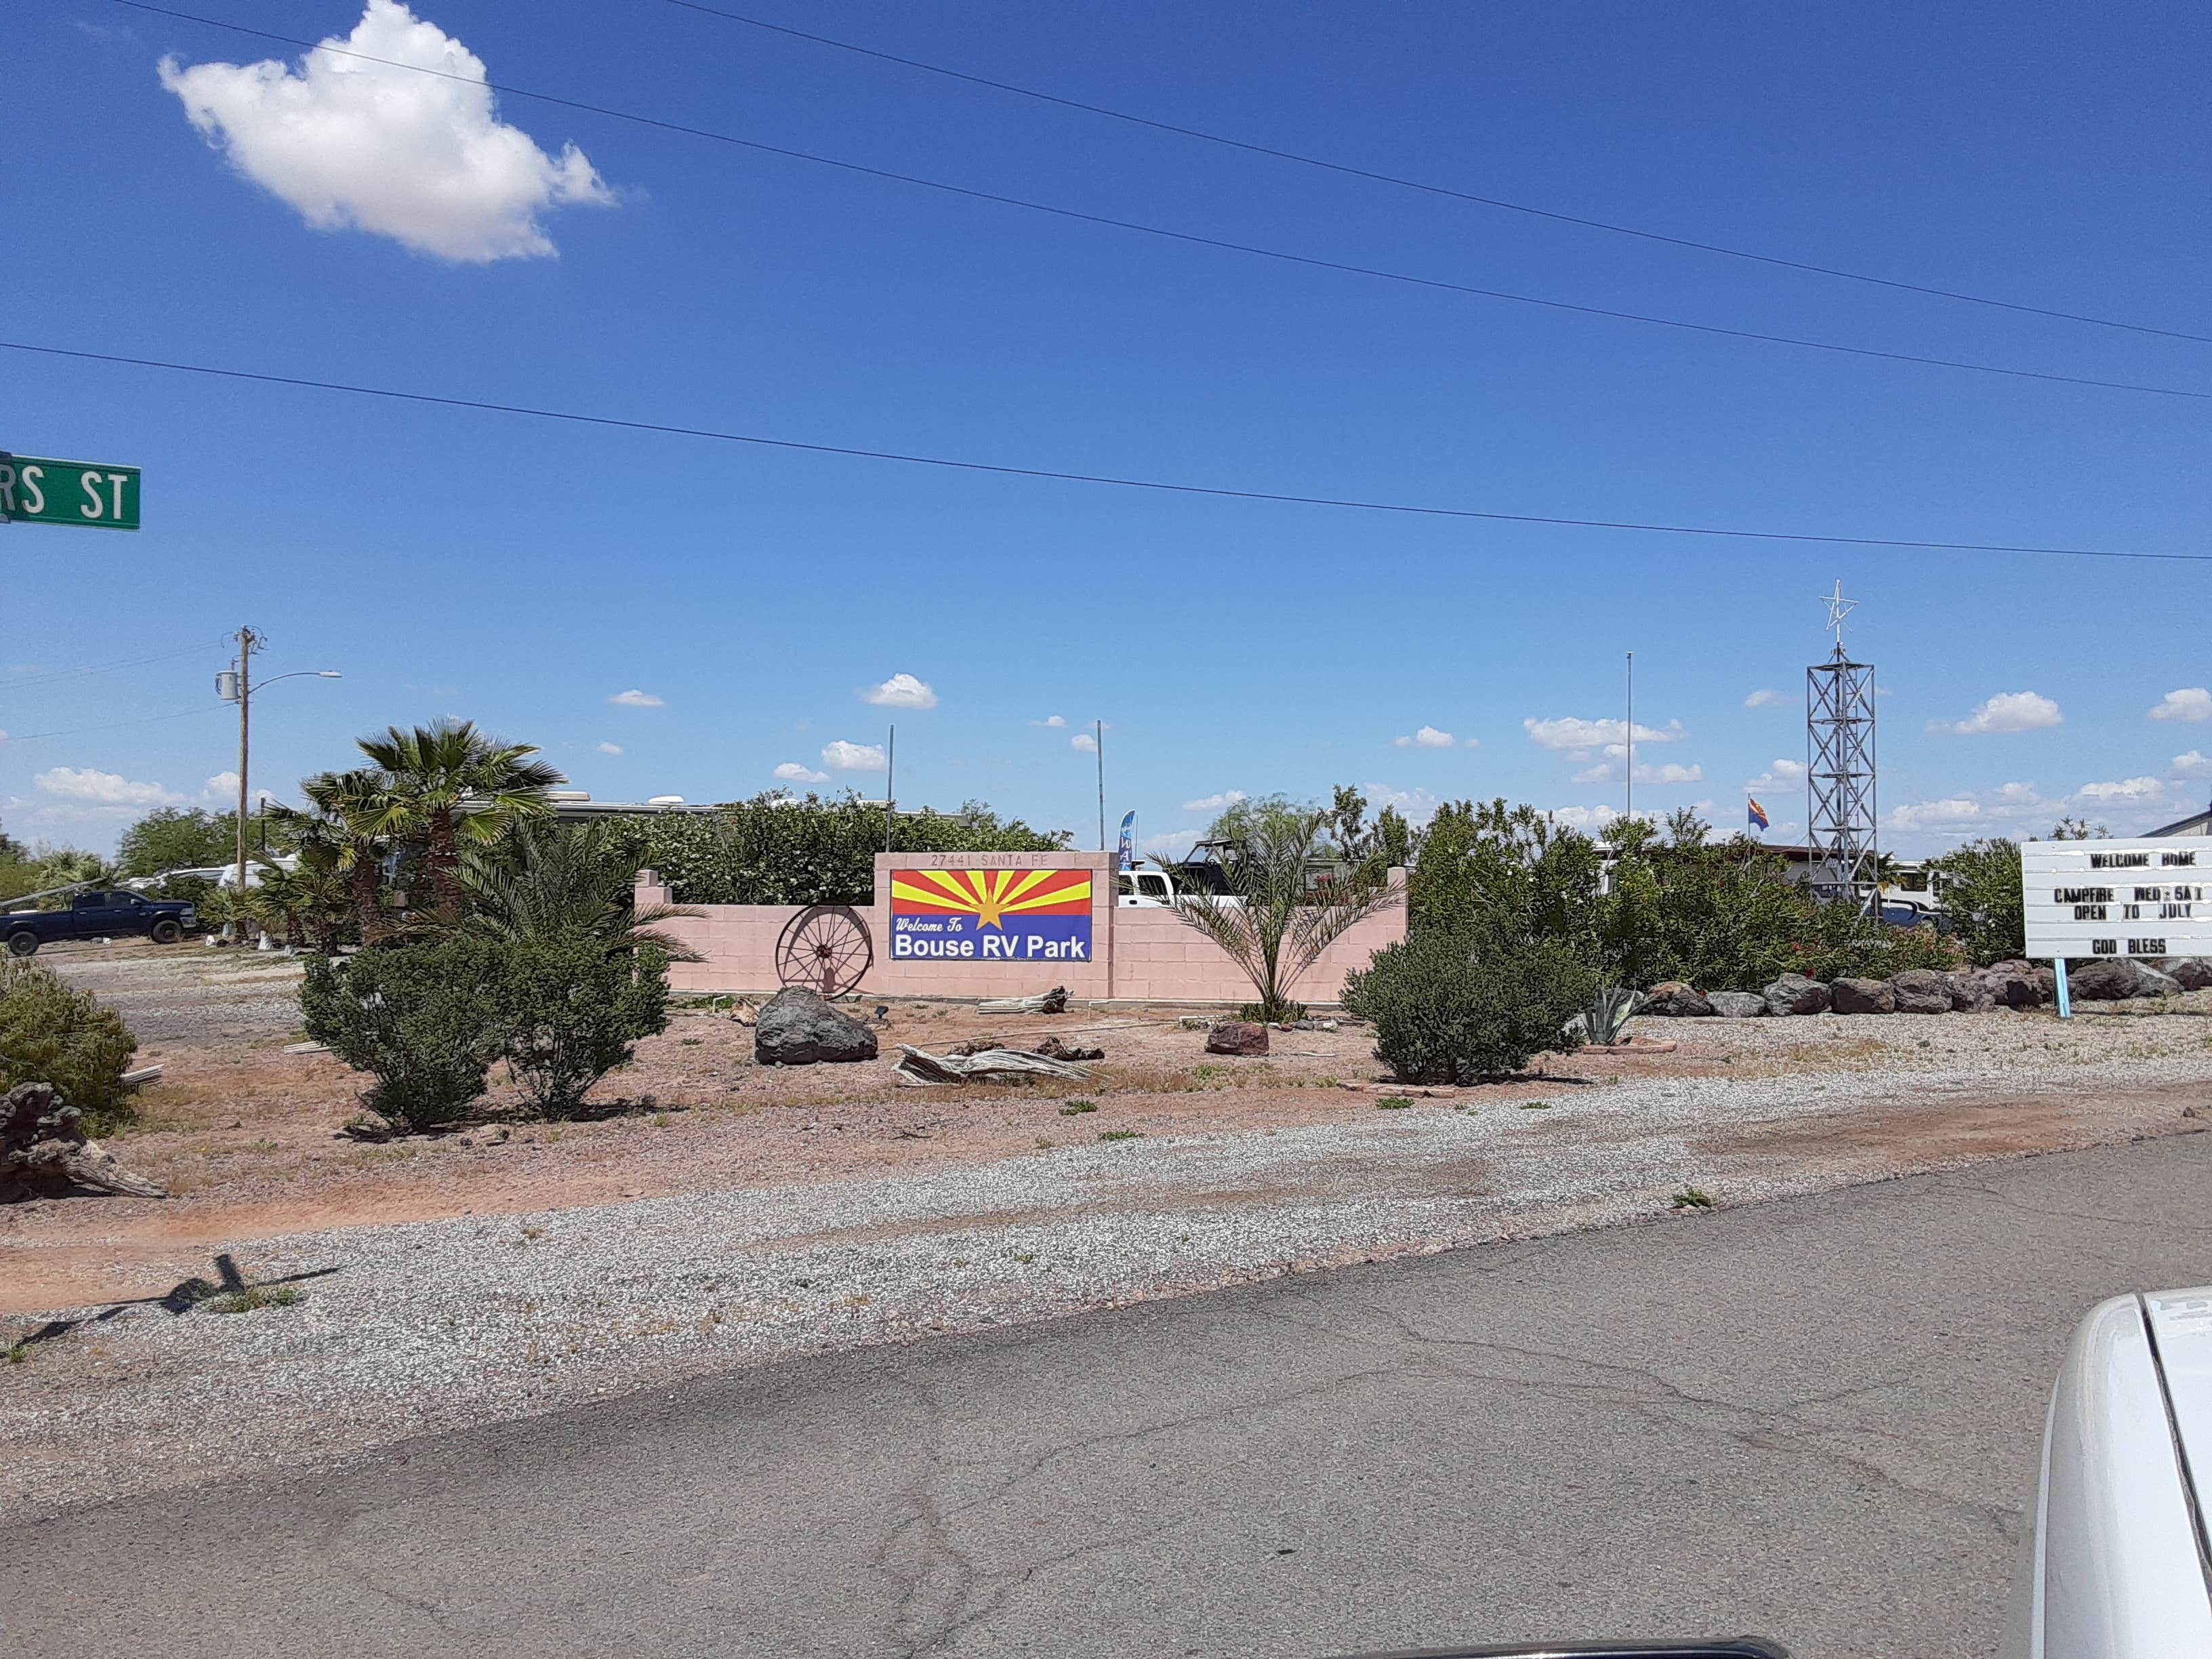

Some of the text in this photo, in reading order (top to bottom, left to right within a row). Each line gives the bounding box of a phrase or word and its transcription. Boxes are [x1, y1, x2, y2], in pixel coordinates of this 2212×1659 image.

[81, 471, 128, 520] ST
[931, 855, 1048, 866] 27441 SANTA FE
[2091, 851, 2196, 868] WELCOME HOME
[2054, 888, 2114, 903] CAMPFIRE
[2135, 886, 2160, 901] WED
[2074, 903, 2191, 920] OPEN TO JULY
[896, 917, 963, 932] Welcome To
[895, 935, 1085, 958] Bouse RV Park
[2093, 939, 2165, 954] GOD BLESS
